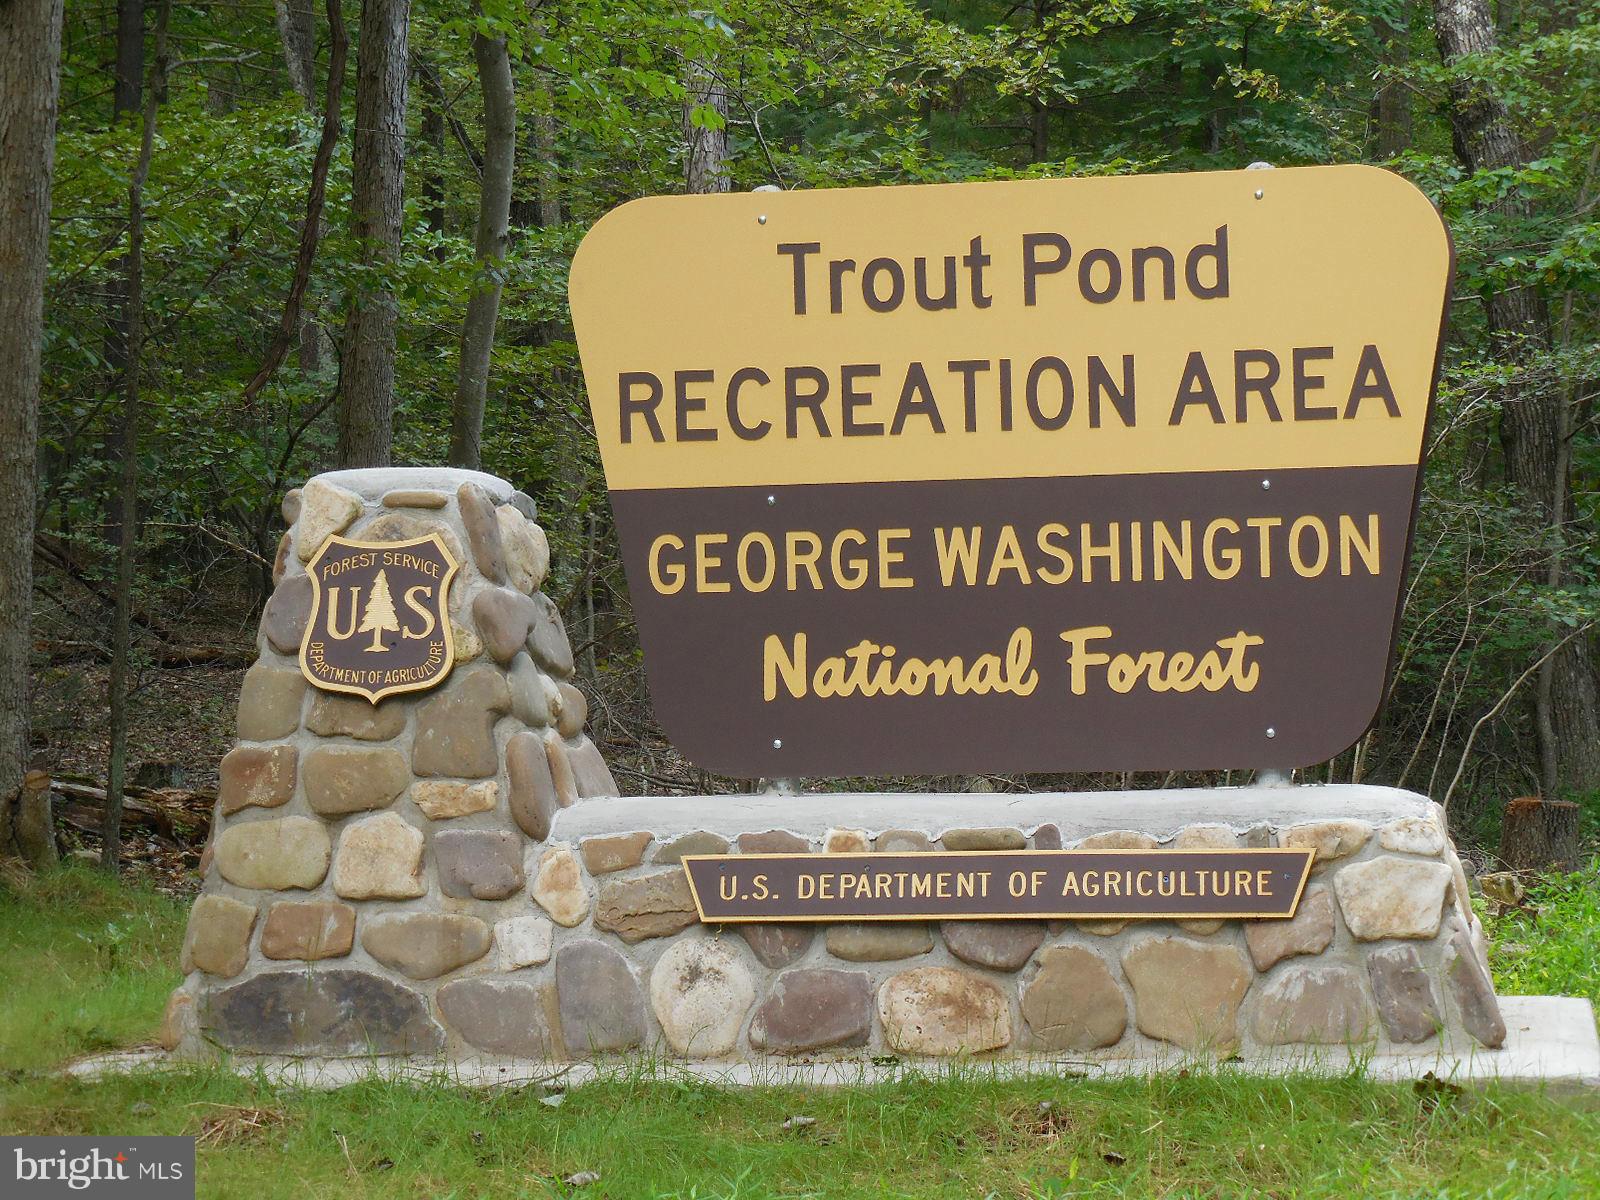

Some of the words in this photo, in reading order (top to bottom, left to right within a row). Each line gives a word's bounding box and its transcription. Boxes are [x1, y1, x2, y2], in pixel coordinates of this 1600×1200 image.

[777, 235, 992, 315] Trout
[1022, 224, 1230, 306] Pond
[618, 354, 1138, 444] RECREATION
[1168, 345, 1401, 425] AREA
[323, 552, 378, 581] FOREST
[383, 552, 440, 579] SERVICE
[648, 527, 914, 595] GEORGE
[933, 513, 1381, 587] WASHINGTON
[327, 586, 361, 640] U
[402, 586, 436, 640] S
[309, 642, 366, 683] DEPARTMENT
[368, 670, 383, 684] OF
[384, 641, 444, 683] AGRICULTURE
[763, 626, 1039, 702] National
[1060, 625, 1264, 696] Forest
[719, 874, 779, 901] U.S.
[798, 871, 992, 900] DEPARTMENT
[1008, 870, 1047, 898] OF
[1061, 869, 1273, 898] AGRICULTURE
